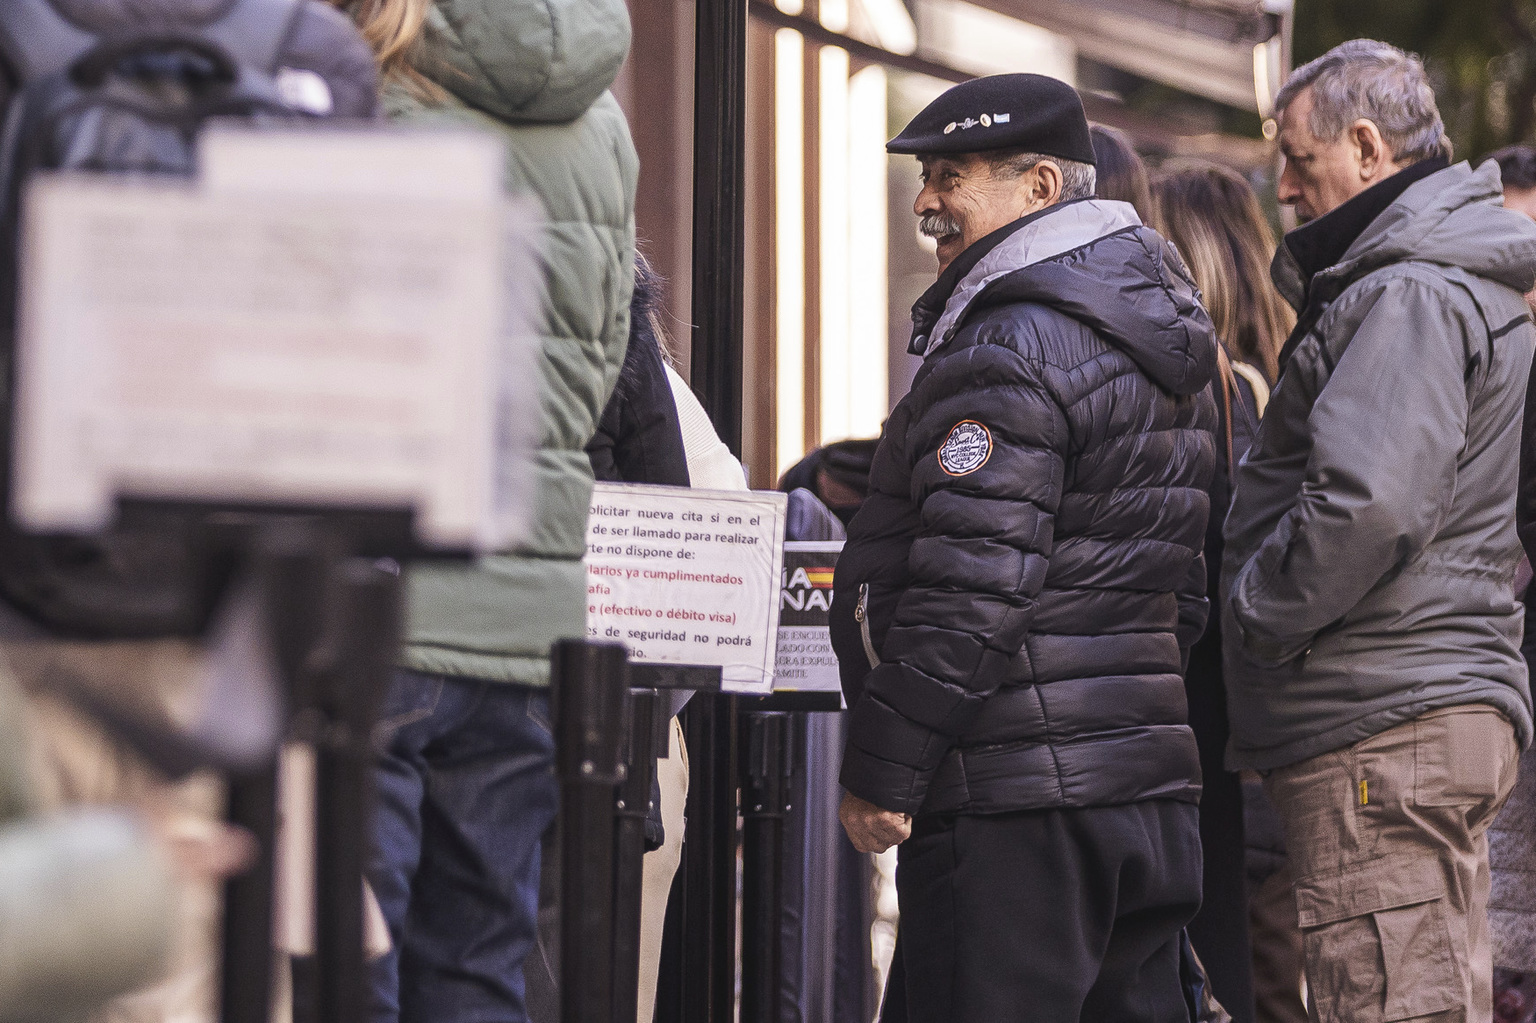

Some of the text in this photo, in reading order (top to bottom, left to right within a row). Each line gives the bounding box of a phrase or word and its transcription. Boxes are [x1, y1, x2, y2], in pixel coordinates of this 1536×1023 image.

[638, 510, 674, 520] nueva
[681, 511, 703, 522] cita
[711, 512, 720, 523] si
[727, 516, 742, 525] en
[749, 515, 760, 526] el
[592, 524, 760, 545] de ser llamado para realizar
[607, 546, 622, 555] no
[626, 544, 673, 559] dispone
[677, 548, 696, 560] de:
[588, 564, 743, 585] larios ya cumplimentados
[600, 604, 652, 618] (efectivo
[655, 610, 663, 618] o
[666, 608, 706, 622] débito
[708, 611, 737, 625] visa)
[605, 626, 620, 637] de
[627, 629, 686, 643] seguridad
[694, 634, 709, 643] no
[716, 634, 752, 647] podrá
